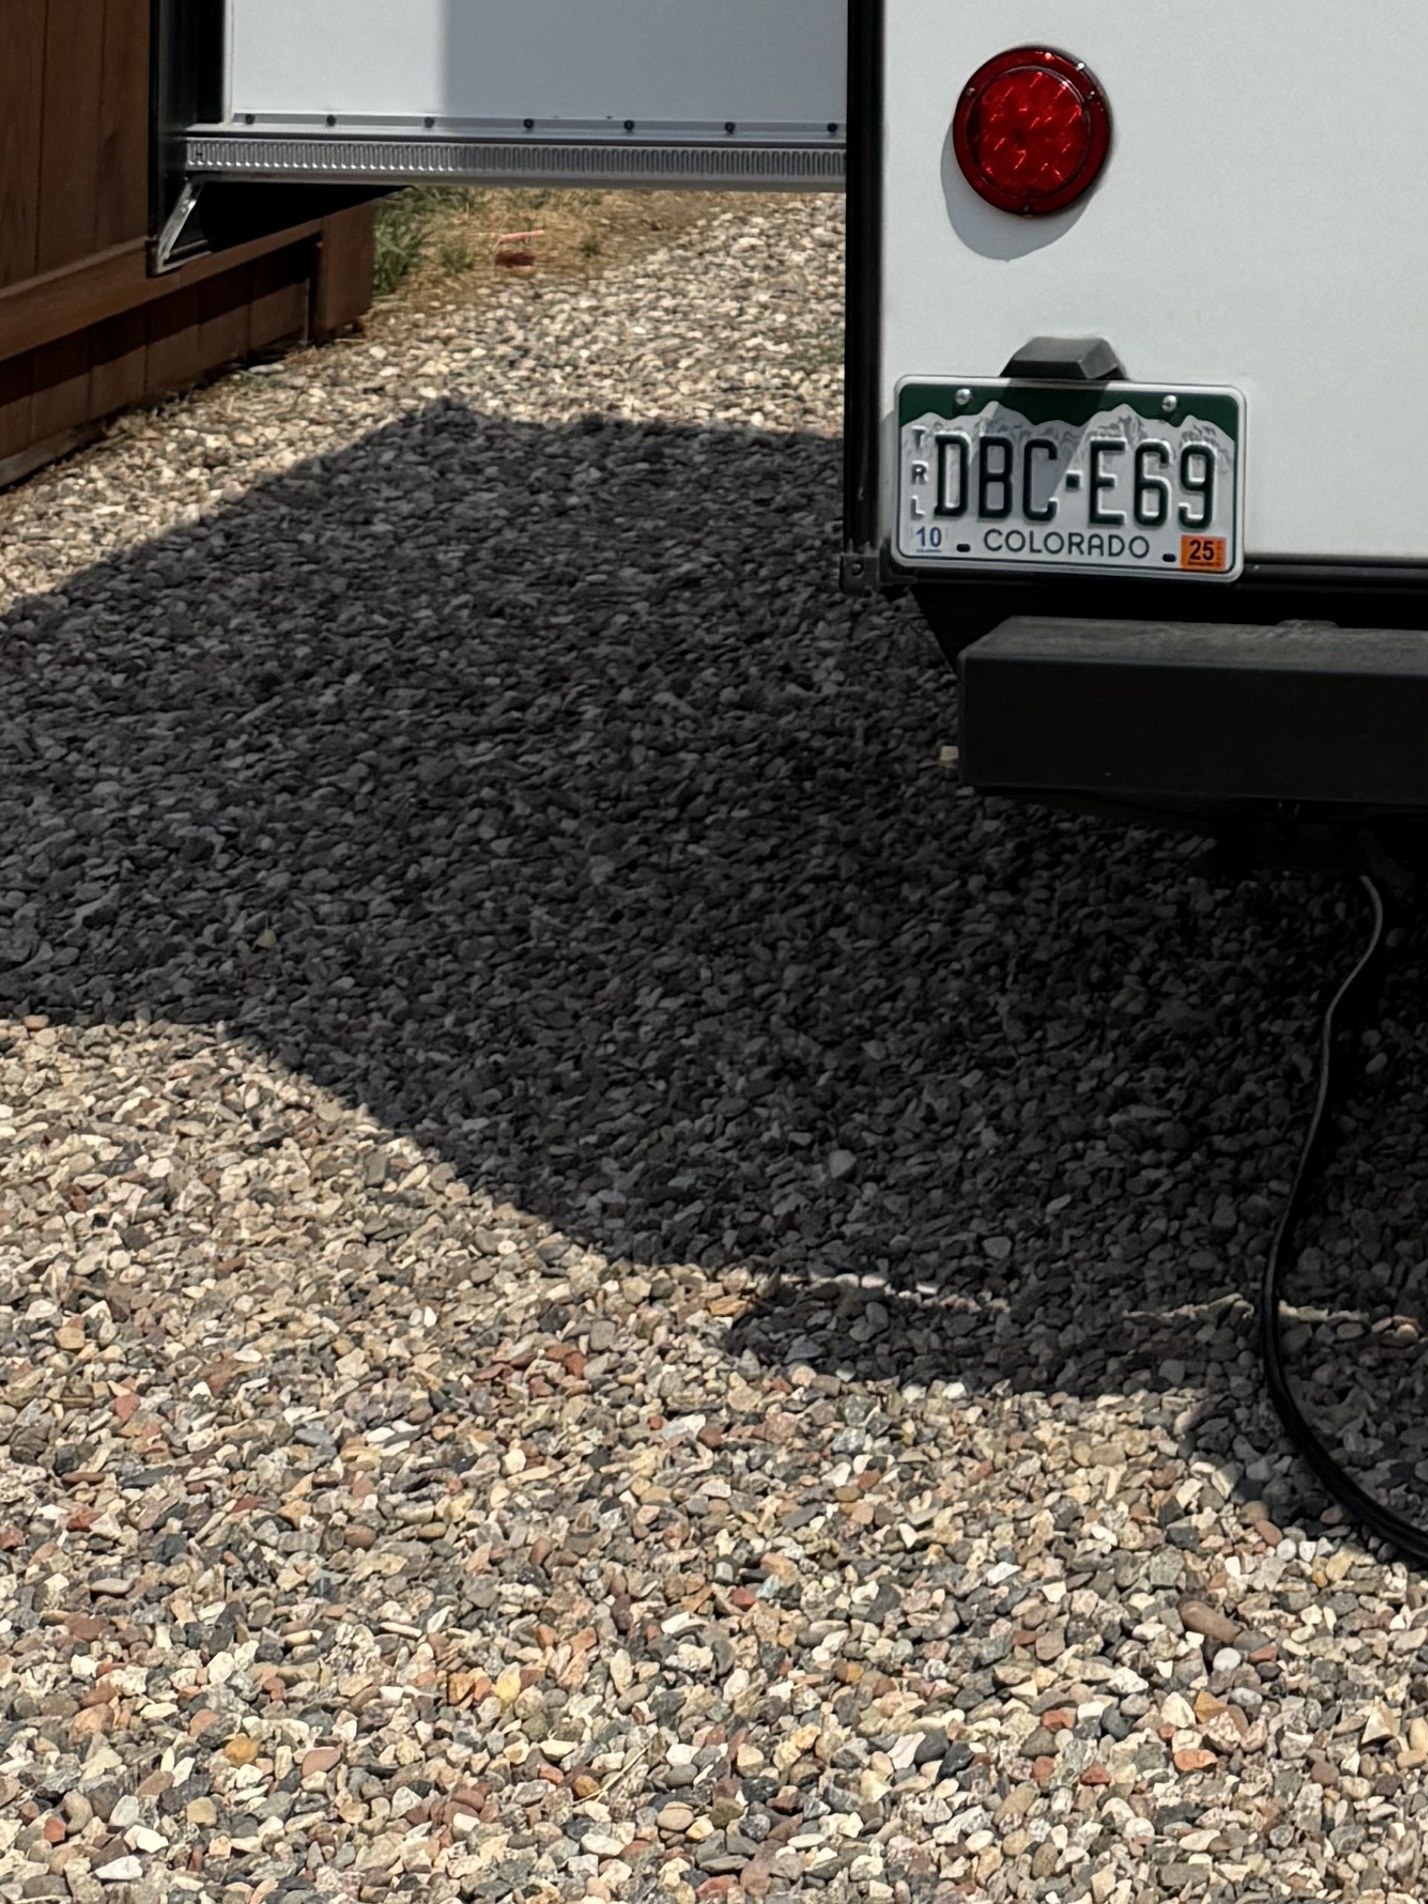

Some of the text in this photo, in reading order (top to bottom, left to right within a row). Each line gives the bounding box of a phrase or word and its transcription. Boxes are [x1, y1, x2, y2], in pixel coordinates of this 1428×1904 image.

[915, 526, 943, 548] 10
[983, 528, 1151, 559] COLORADO
[1189, 539, 1215, 561] 25
